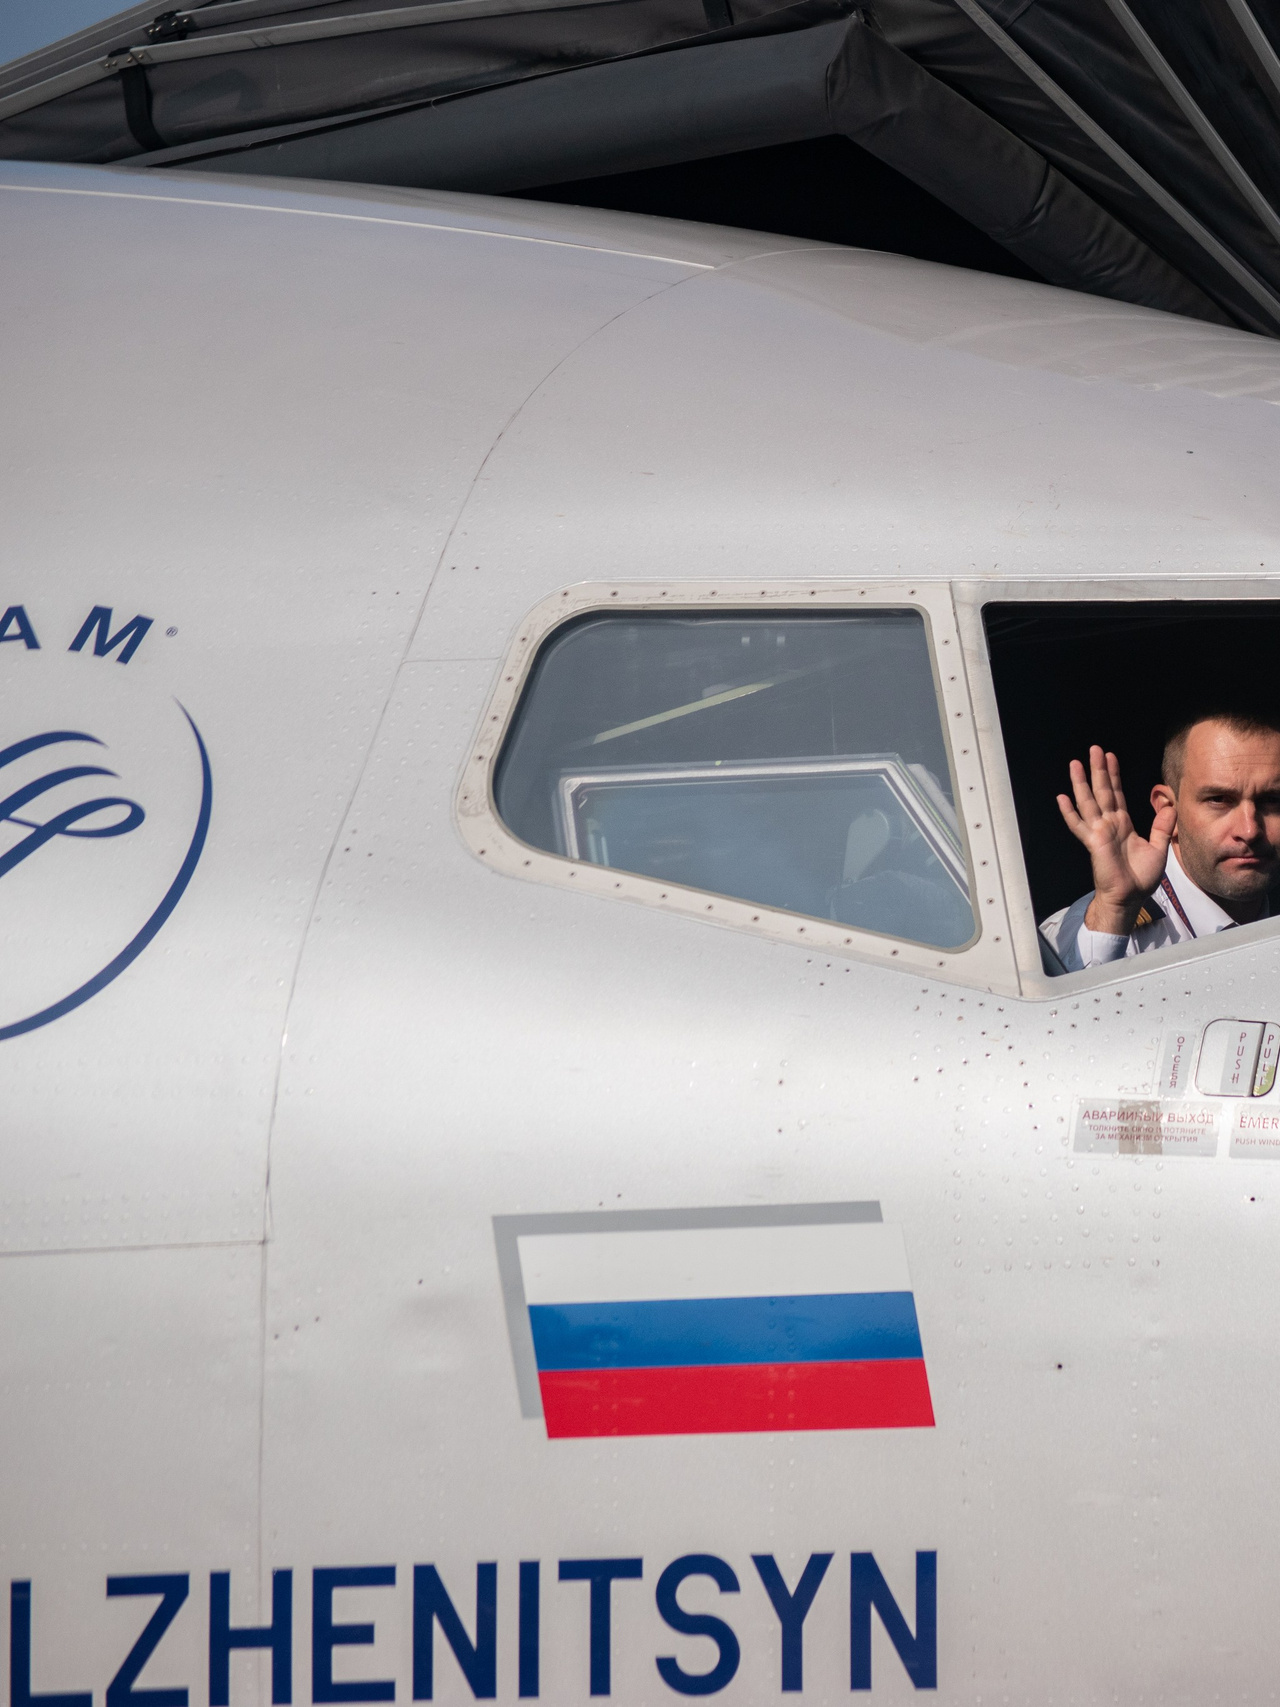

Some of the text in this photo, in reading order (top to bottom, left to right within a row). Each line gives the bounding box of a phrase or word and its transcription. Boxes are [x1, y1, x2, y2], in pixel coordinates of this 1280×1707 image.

[1231, 1032, 1247, 1084] PUSH
[1260, 1034, 1275, 1086] PULL
[1163, 1127, 1206, 1135] ПОТЯНИТЕ
[1167, 1112, 1214, 1126] ВЫХОД
[1235, 1137, 1256, 1145] PUSH
[9, 1549, 938, 1707] LZHENITSYN
